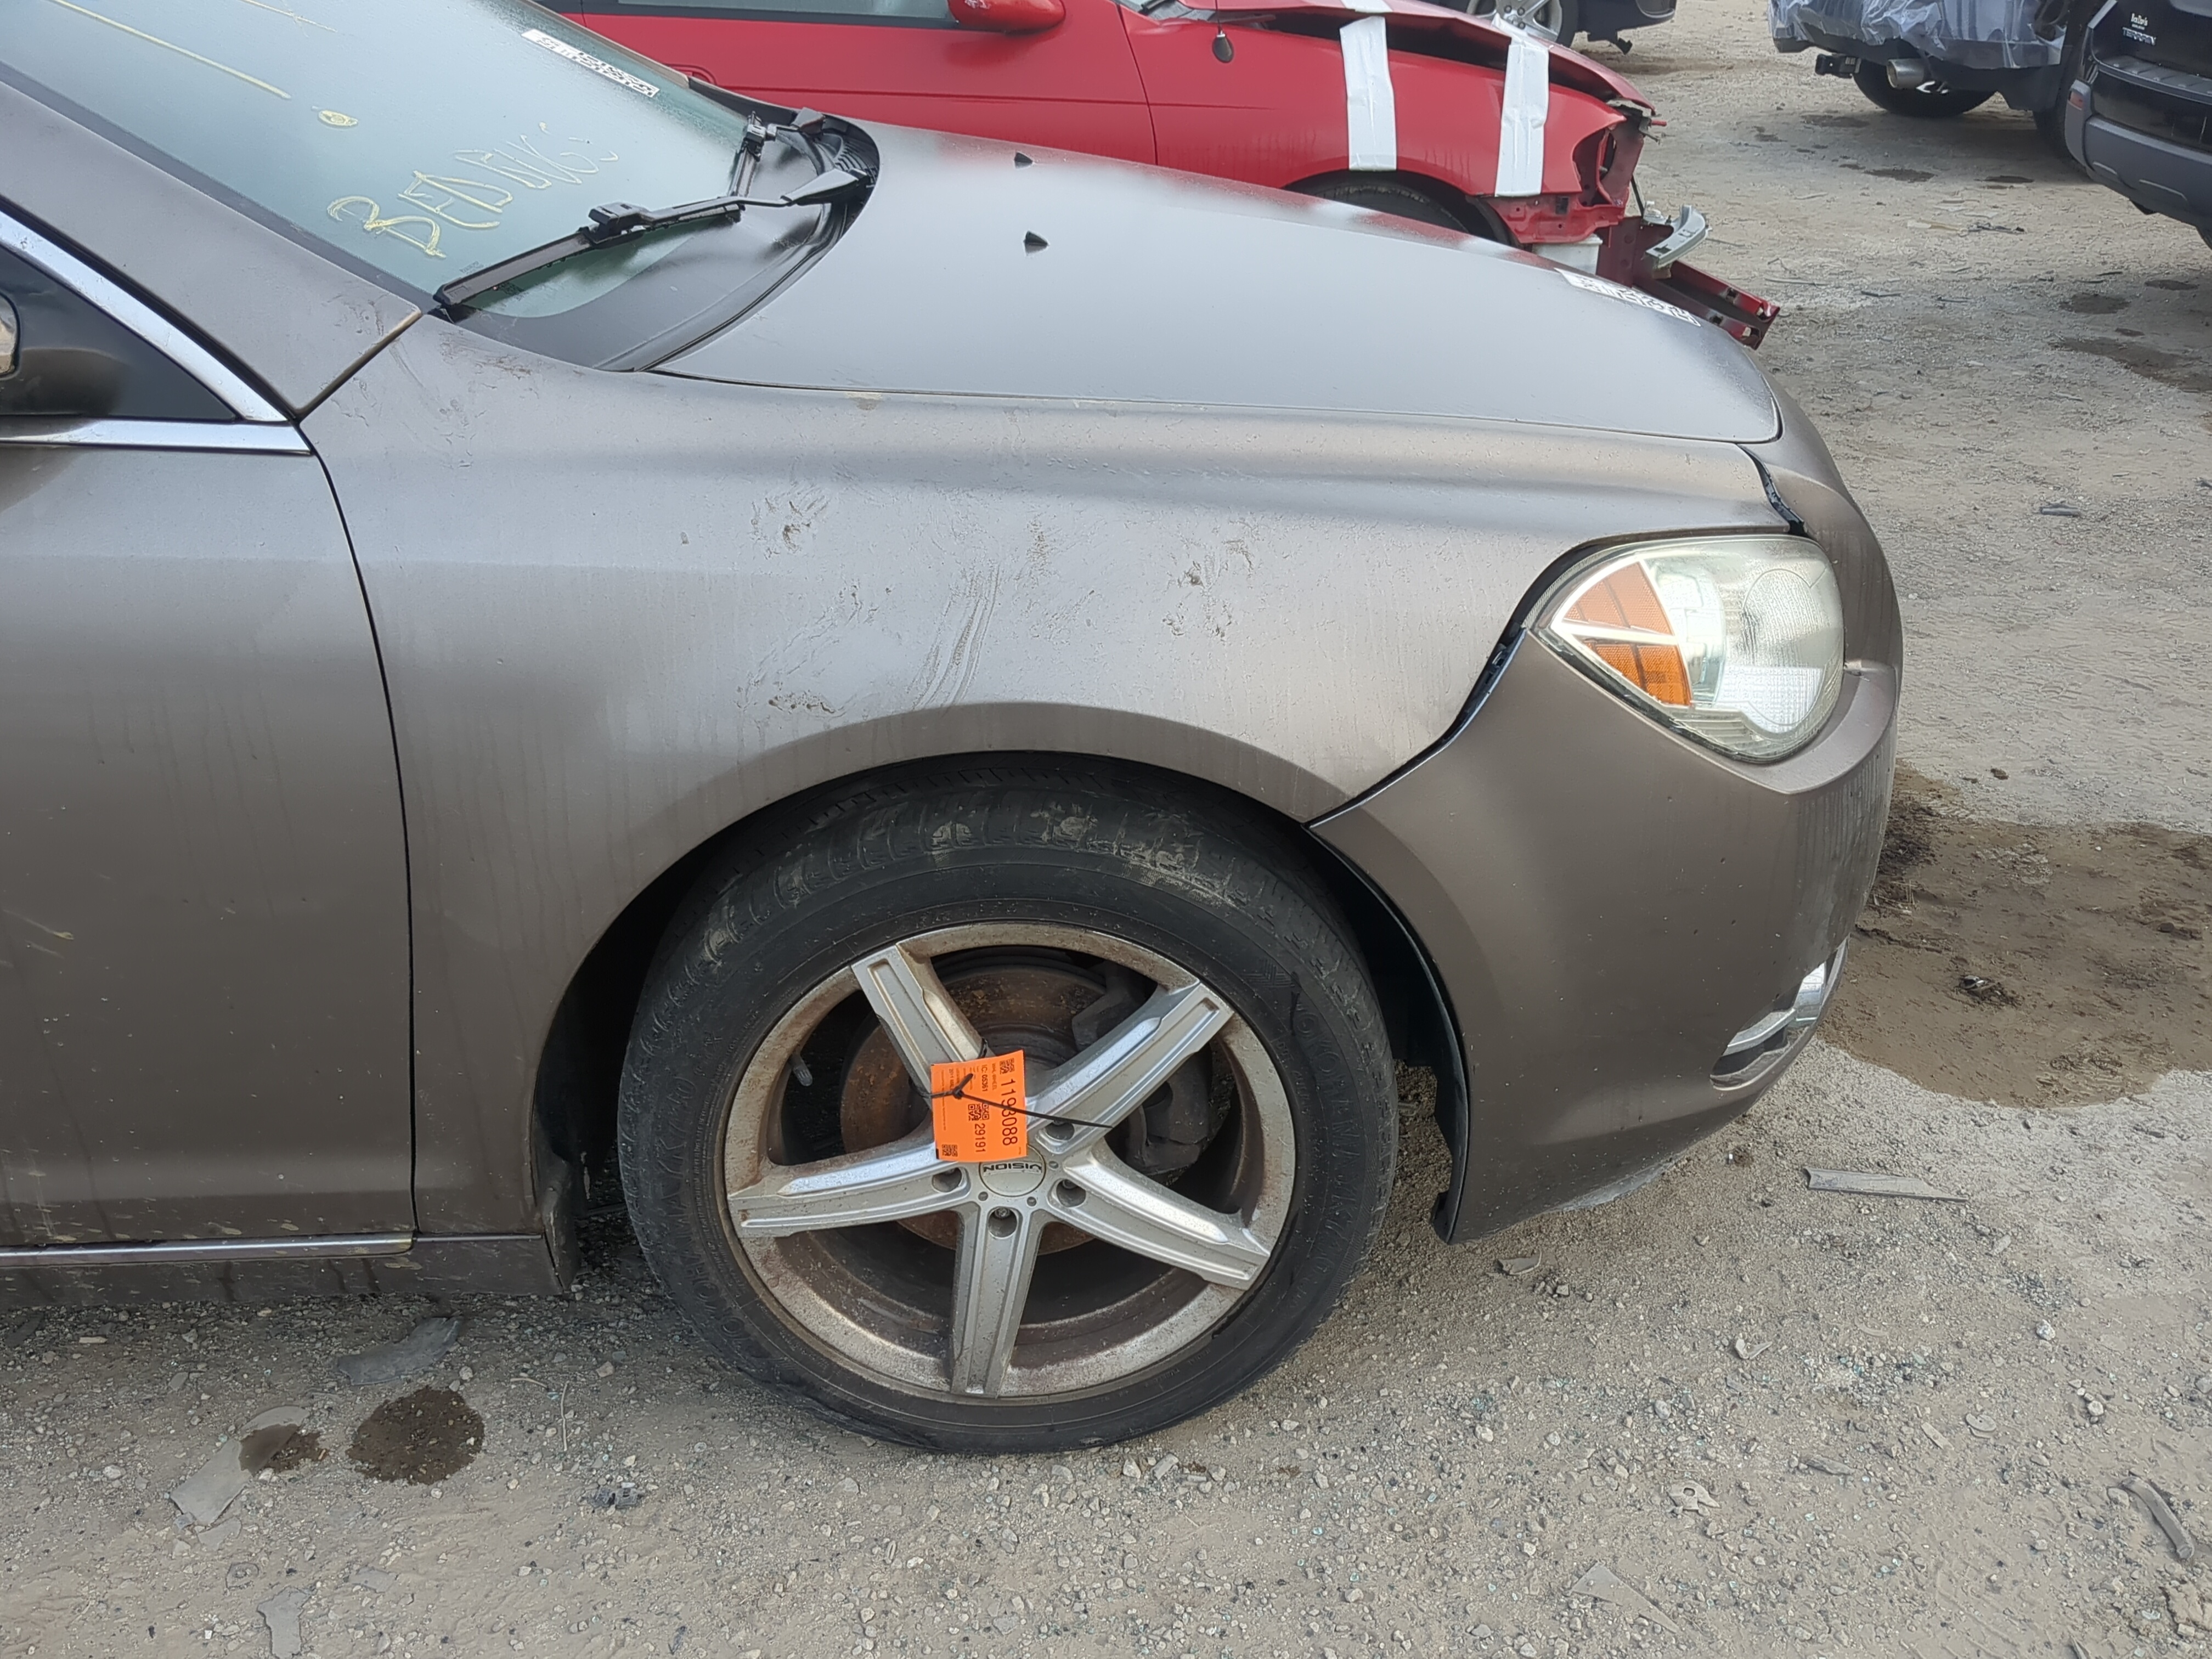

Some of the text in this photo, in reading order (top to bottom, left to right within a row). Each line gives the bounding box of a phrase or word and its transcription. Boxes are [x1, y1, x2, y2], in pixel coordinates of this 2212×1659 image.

[1001, 1078, 1018, 1146] 1193088
[975, 1123, 986, 1152] 29191
[984, 1163, 1042, 1173] VISION
